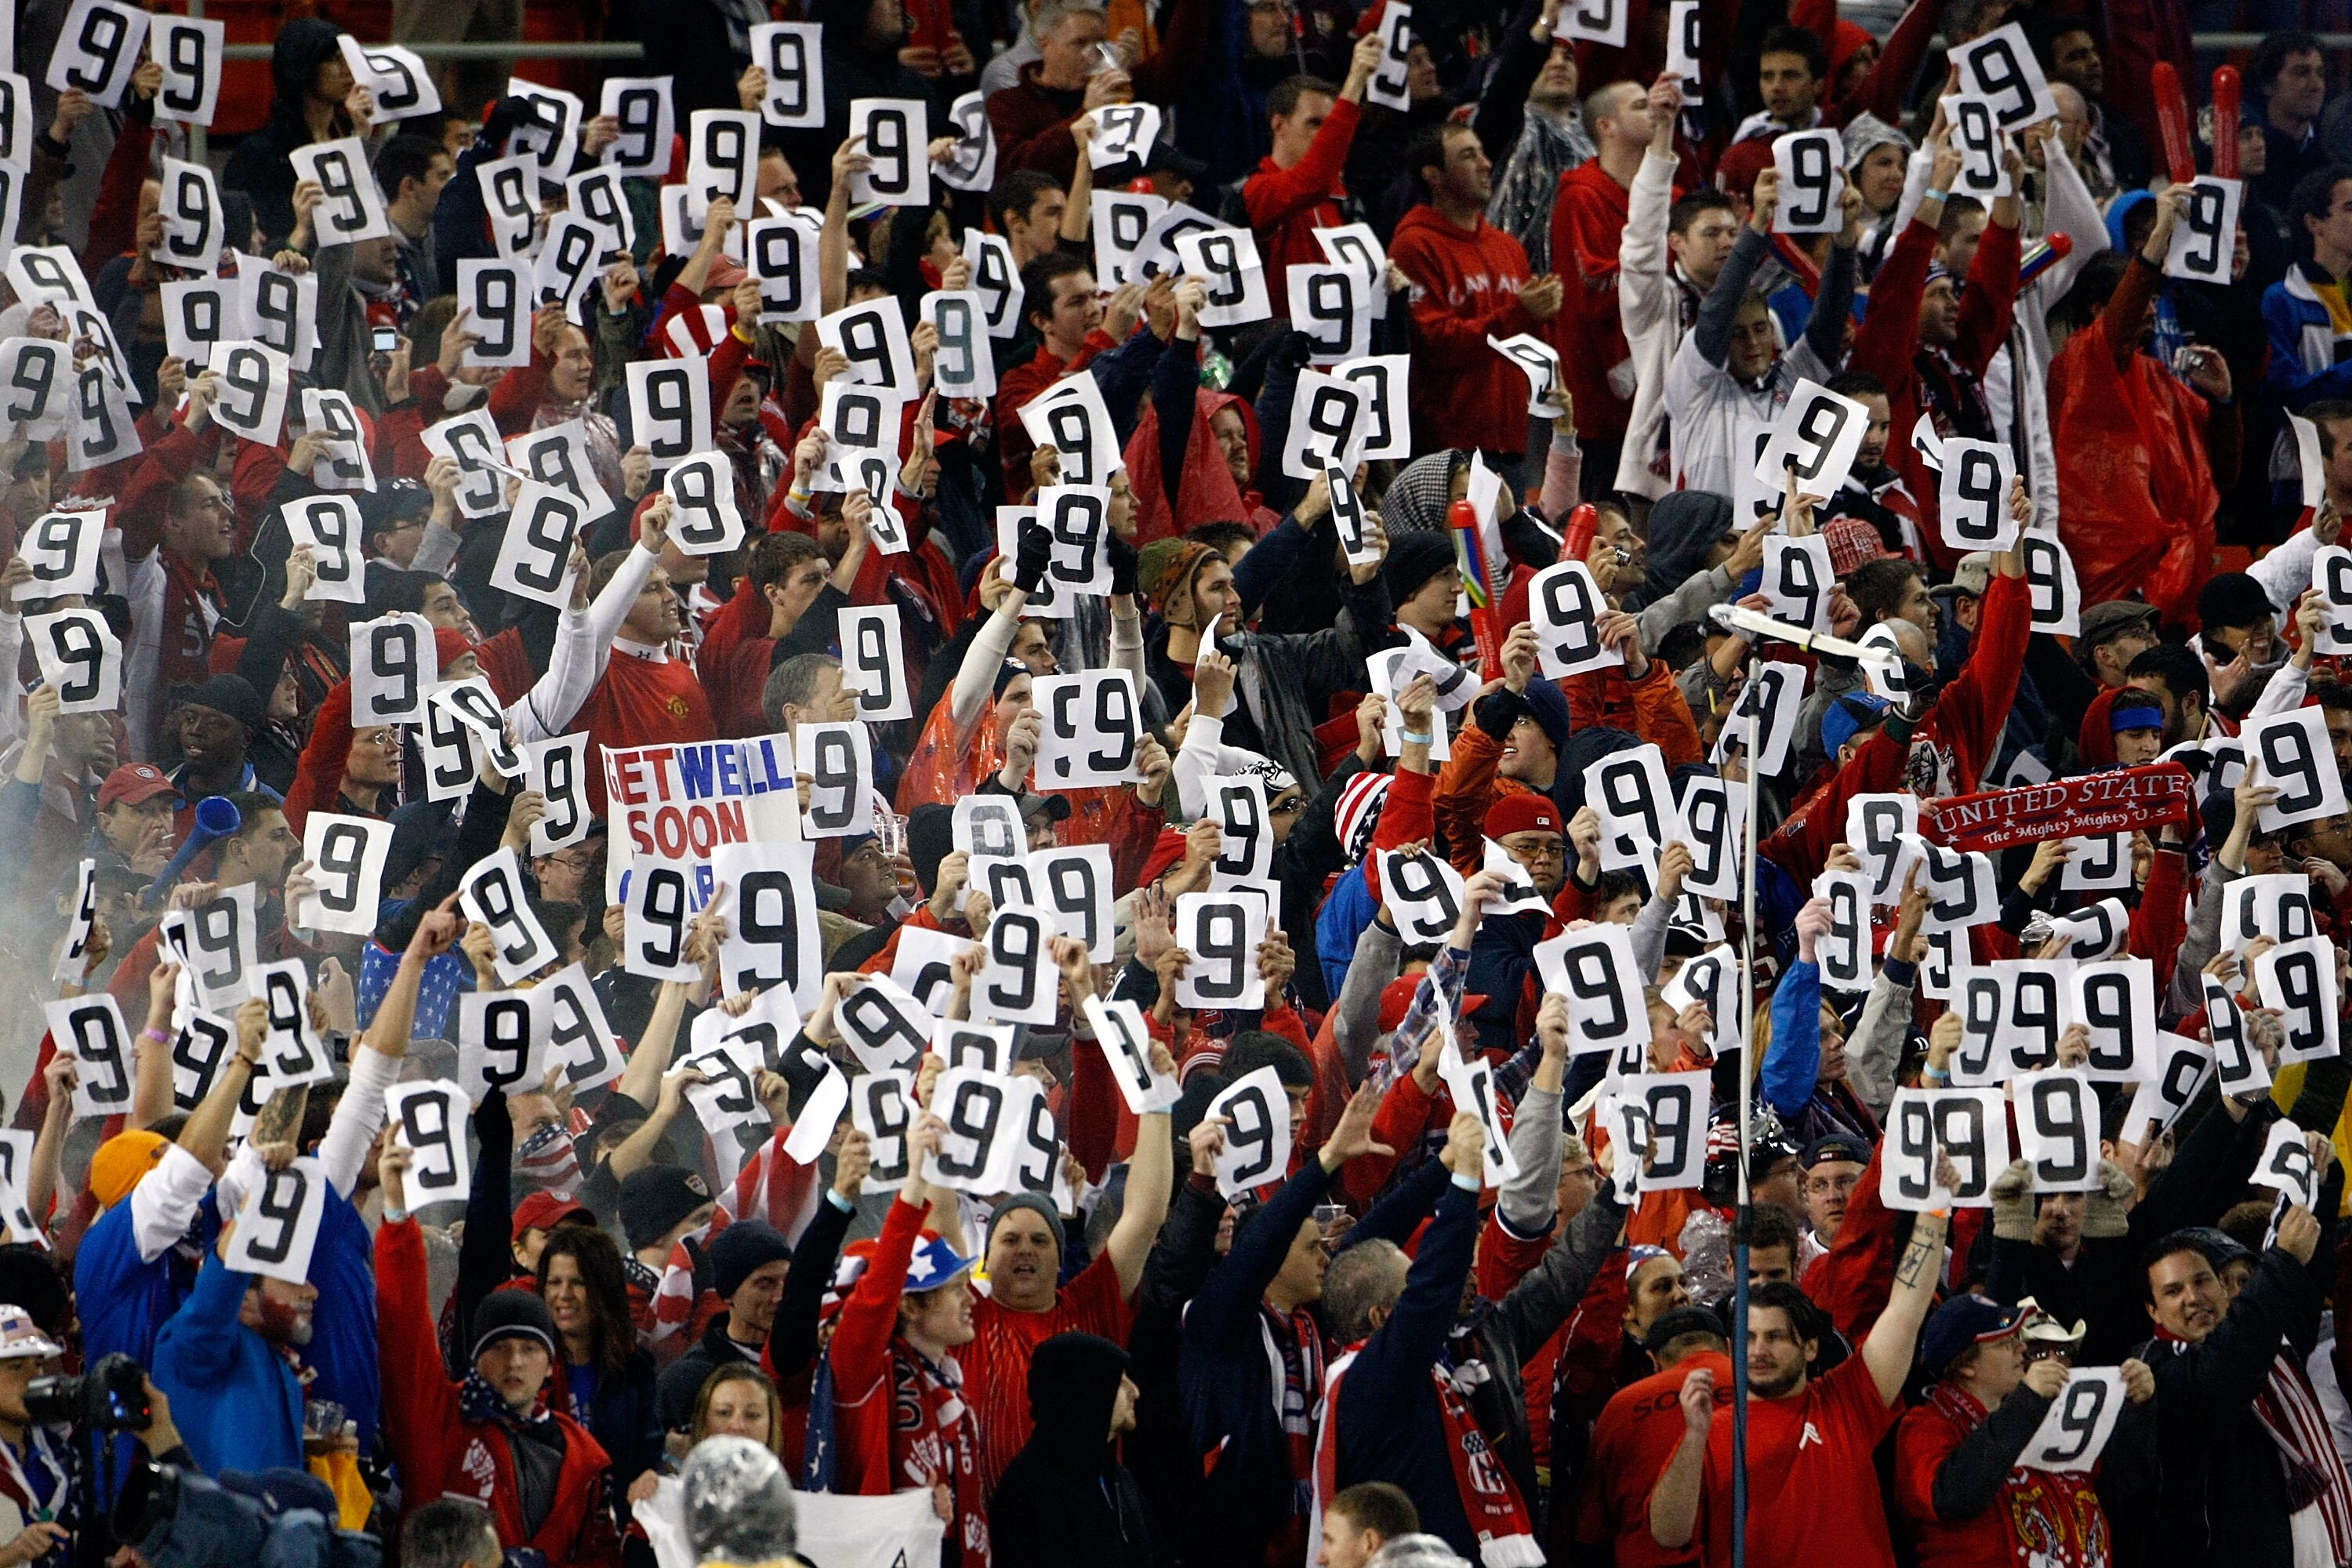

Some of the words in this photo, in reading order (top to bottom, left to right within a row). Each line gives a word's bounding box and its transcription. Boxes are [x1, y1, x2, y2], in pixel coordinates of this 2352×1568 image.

[66, 6, 129, 94] 9
[164, 26, 205, 111] 9
[365, 54, 420, 109] 9
[773, 33, 808, 117] 9
[1377, 15, 1412, 95] 9
[1967, 38, 2036, 122] 9
[515, 93, 568, 167] 9
[615, 89, 660, 166] 9
[706, 121, 746, 204] 9
[866, 109, 910, 195] 9
[1103, 107, 1144, 153] 9
[1959, 102, 1998, 189] 9
[169, 172, 210, 257] 9
[314, 151, 368, 232] 9
[493, 169, 535, 252] 9
[579, 175, 624, 266] 9
[1789, 138, 1830, 226] 9
[540, 225, 595, 307] 9
[756, 227, 801, 313] 9
[1197, 236, 1246, 307] 9
[2185, 184, 2226, 274] 9
[256, 271, 298, 356] 9
[475, 270, 516, 357] 9
[978, 243, 1011, 327] 9
[1308, 274, 1354, 354] 9
[8, 345, 56, 420] 9
[840, 312, 896, 388] 9
[935, 299, 974, 384] 9
[78, 368, 118, 458] 9
[220, 348, 270, 430] 9
[646, 368, 692, 458] 9
[1301, 386, 1358, 470] 9
[318, 398, 365, 480] 9
[445, 423, 499, 510] 9
[530, 436, 589, 510] 9
[1047, 403, 1091, 485] 9
[1783, 395, 1849, 480] 9
[674, 462, 725, 545] 9
[859, 458, 898, 544] 9
[1051, 493, 1102, 583] 9
[1330, 466, 1363, 554] 9
[1957, 448, 2002, 540] 9
[32, 517, 82, 582] 9
[305, 502, 347, 583] 9
[514, 496, 579, 593] 9
[2022, 537, 2063, 624] 9
[1541, 571, 1601, 665] 9
[1772, 546, 1819, 630] 9
[49, 618, 103, 703] 9
[371, 623, 416, 716] 9
[857, 616, 891, 711] 9
[430, 694, 474, 786] 9
[452, 685, 519, 770] 9
[1089, 679, 1134, 772] 9
[1723, 668, 1785, 759] 9
[544, 746, 579, 841] 9
[605, 748, 674, 807] GET
[674, 739, 794, 801] WELL
[811, 731, 857, 829] 9
[1601, 760, 1662, 857] 9
[1932, 786, 2067, 833] UNITED
[2259, 722, 2323, 815] 9
[319, 822, 368, 913] 9
[626, 800, 749, 860] SOON
[1217, 786, 1258, 875] 9
[1689, 788, 1726, 886] 9
[1864, 800, 1904, 896] 9
[1984, 830, 2011, 845] The
[2016, 820, 2070, 839] Mighty
[2074, 811, 2129, 829] Mighty
[470, 867, 538, 966] 9
[641, 868, 684, 967] 9
[739, 871, 798, 997] 9
[1047, 858, 1097, 952] 9
[1388, 854, 1460, 936] 9
[1826, 881, 1859, 981] 9
[193, 897, 238, 996] 9
[989, 913, 1040, 1009] 9
[1195, 904, 1246, 999] 9
[267, 971, 315, 1076] 9
[552, 985, 608, 1083] 9
[1565, 942, 1628, 1040] 9
[1960, 978, 2001, 1073] 9
[2010, 972, 2057, 1069] 9
[2082, 974, 2133, 1070] 9
[2207, 985, 2250, 1082] 9
[2274, 951, 2324, 1051] 9
[69, 1006, 130, 1105] 9
[173, 1018, 230, 1111] 9
[481, 1000, 529, 1085] 9
[684, 1049, 754, 1113] 9
[400, 1091, 458, 1189] 9
[868, 1079, 909, 1181] 9
[938, 1081, 1004, 1178] 9
[1019, 1094, 1059, 1190] 9
[1221, 1085, 1272, 1183] 9
[1649, 1085, 1690, 1178] 9
[1899, 1101, 1933, 1200] 9
[1933, 1098, 1985, 1197] 9
[2031, 1078, 2087, 1181] 9
[246, 1167, 308, 1263] 9
[2042, 1380, 2107, 1461] 9
